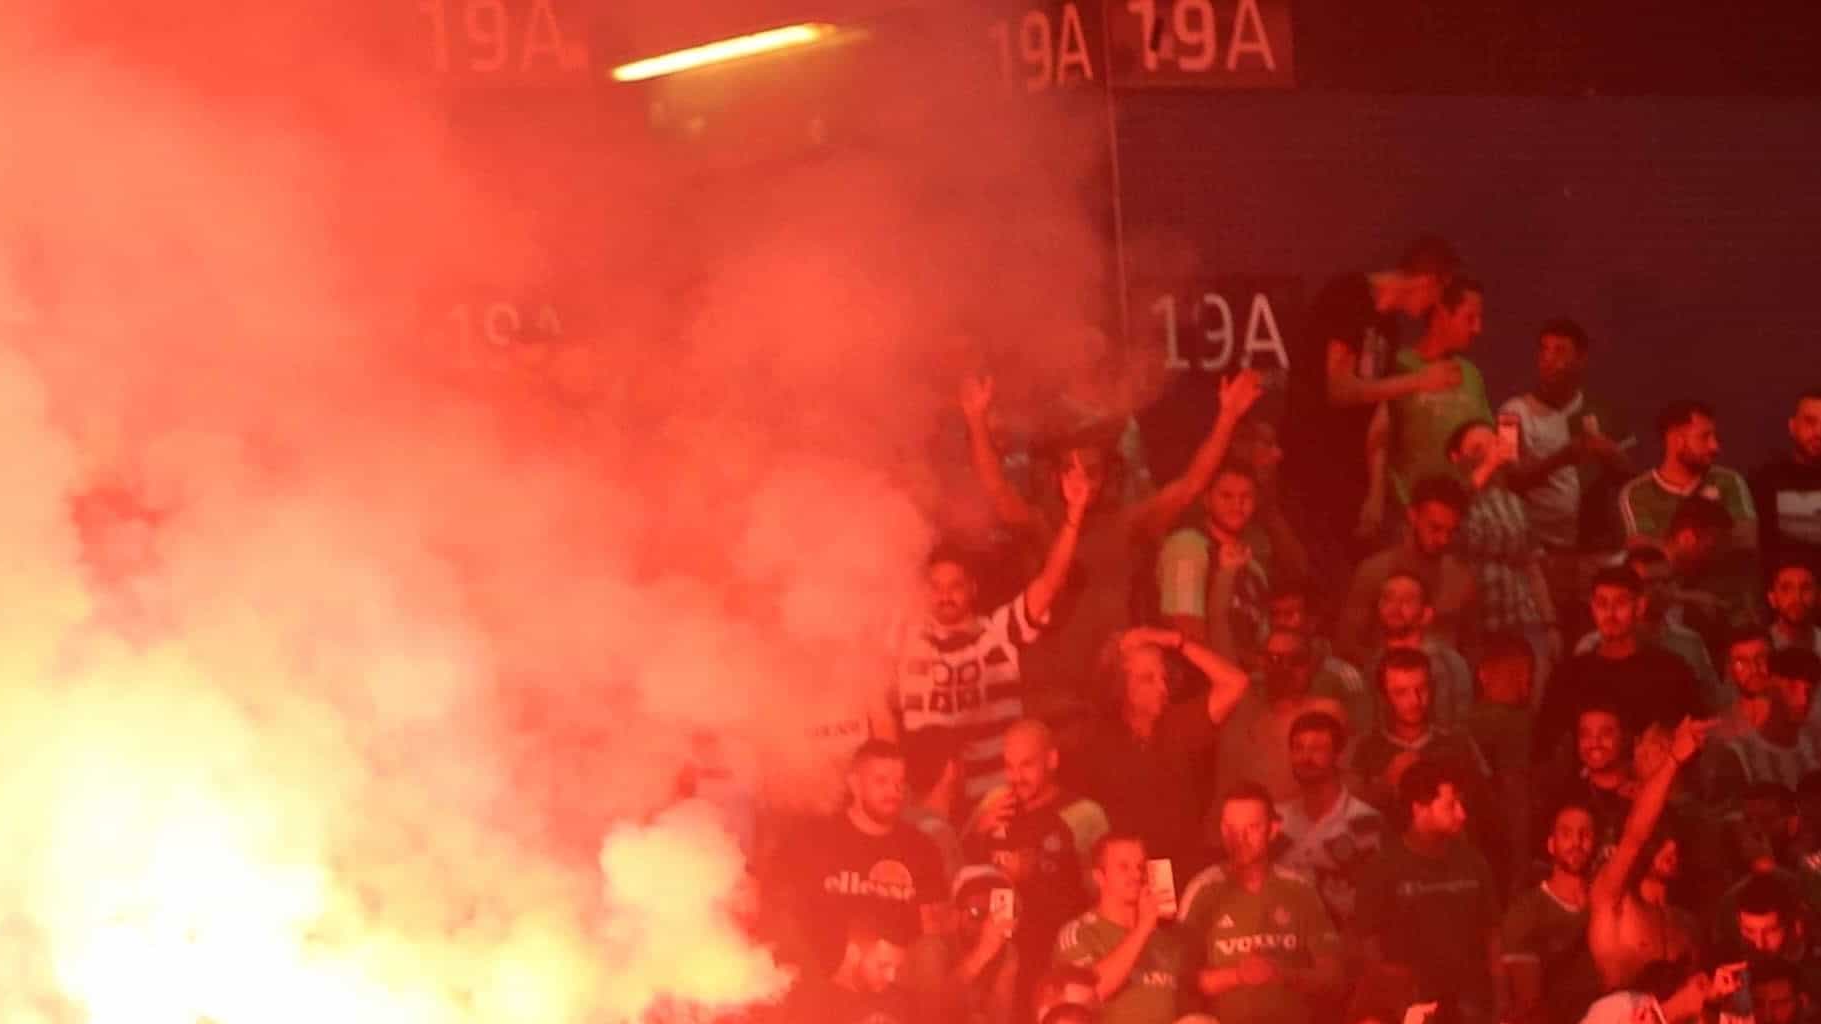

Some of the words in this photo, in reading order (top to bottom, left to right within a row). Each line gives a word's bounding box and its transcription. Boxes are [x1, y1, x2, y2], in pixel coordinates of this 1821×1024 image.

[423, 0, 568, 73] 19A
[988, 3, 1094, 93] 19A
[1127, 0, 1276, 71] 19A
[1149, 293, 1290, 371] 19A
